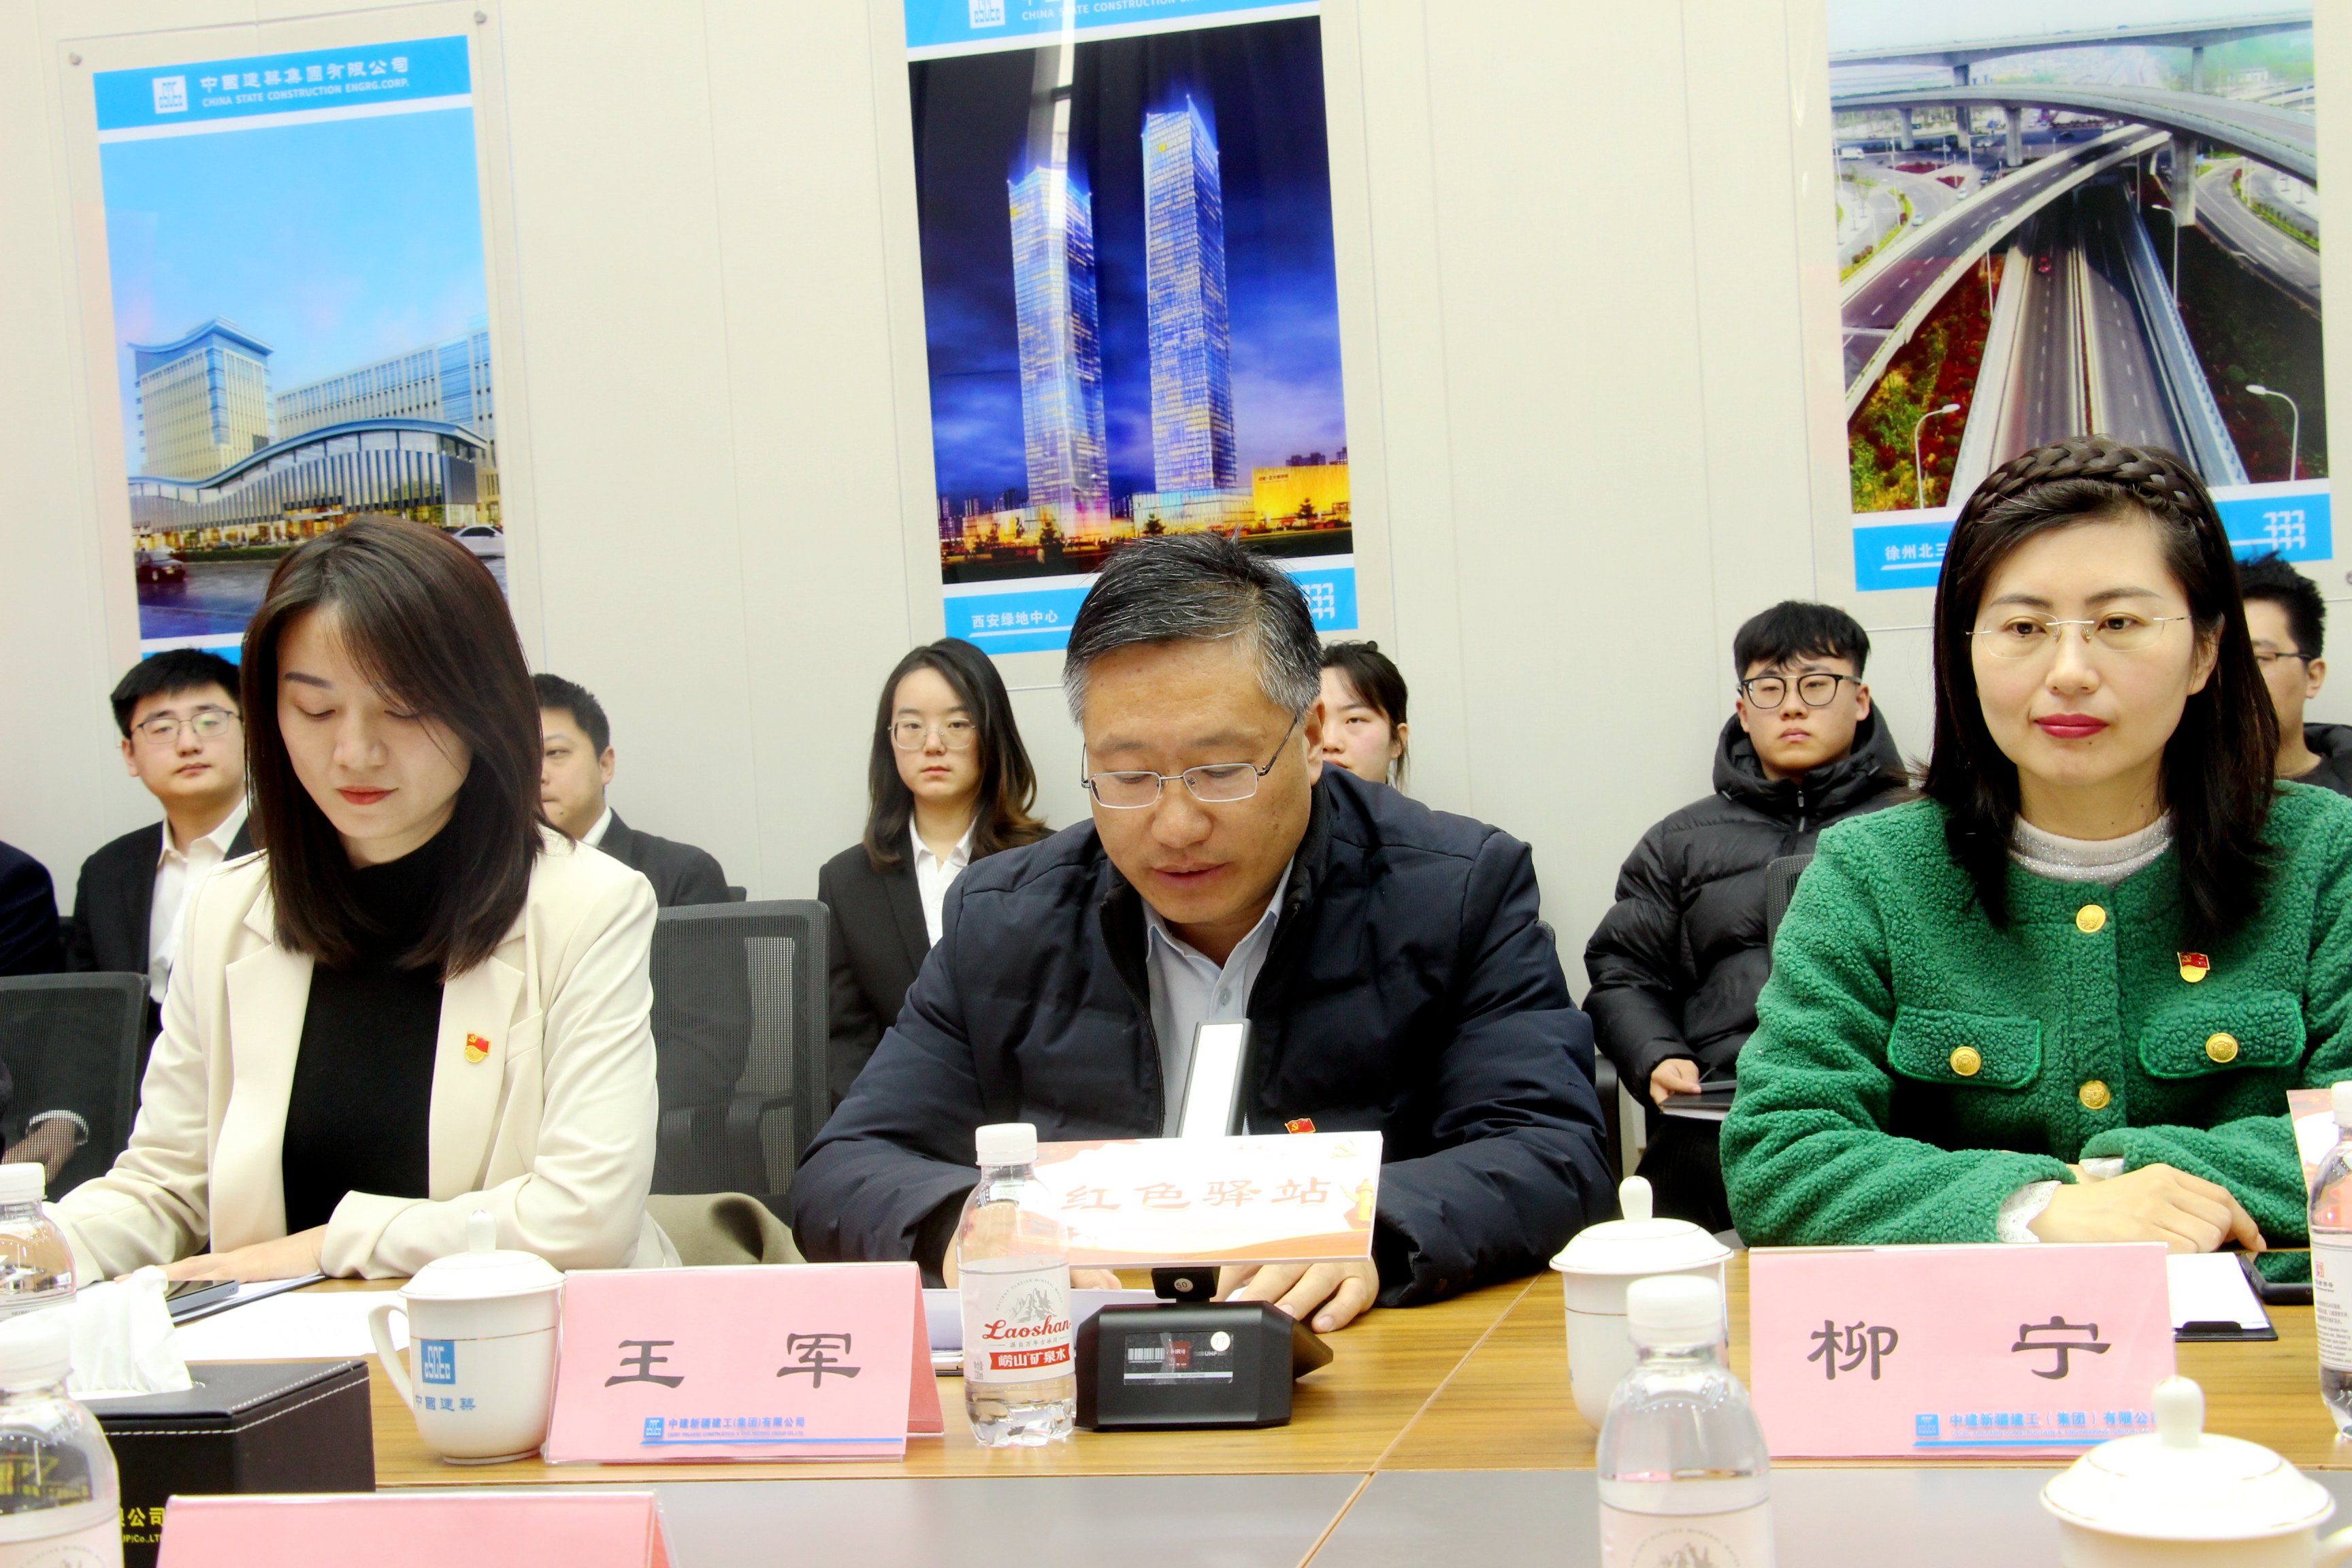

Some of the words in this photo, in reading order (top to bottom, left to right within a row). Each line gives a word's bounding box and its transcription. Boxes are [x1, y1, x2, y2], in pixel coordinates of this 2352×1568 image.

[1022, 10, 1054, 21] CHINA
[1058, 5, 1089, 16] STE
[202, 96, 232, 107] CHINA
[235, 93, 263, 103] STATE
[267, 84, 341, 100] CONSTRUCTION
[971, 610, 1059, 629] 西安绿地中心
[1060, 1177, 1333, 1212] 红色驿站
[982, 1315, 1071, 1339] Laoshan
[1807, 1319, 1899, 1381] 柳
[2011, 1316, 2112, 1380] 宁
[604, 1339, 685, 1389] 王
[777, 1333, 862, 1389] 军
[120, 1507, 165, 1526] 公司
